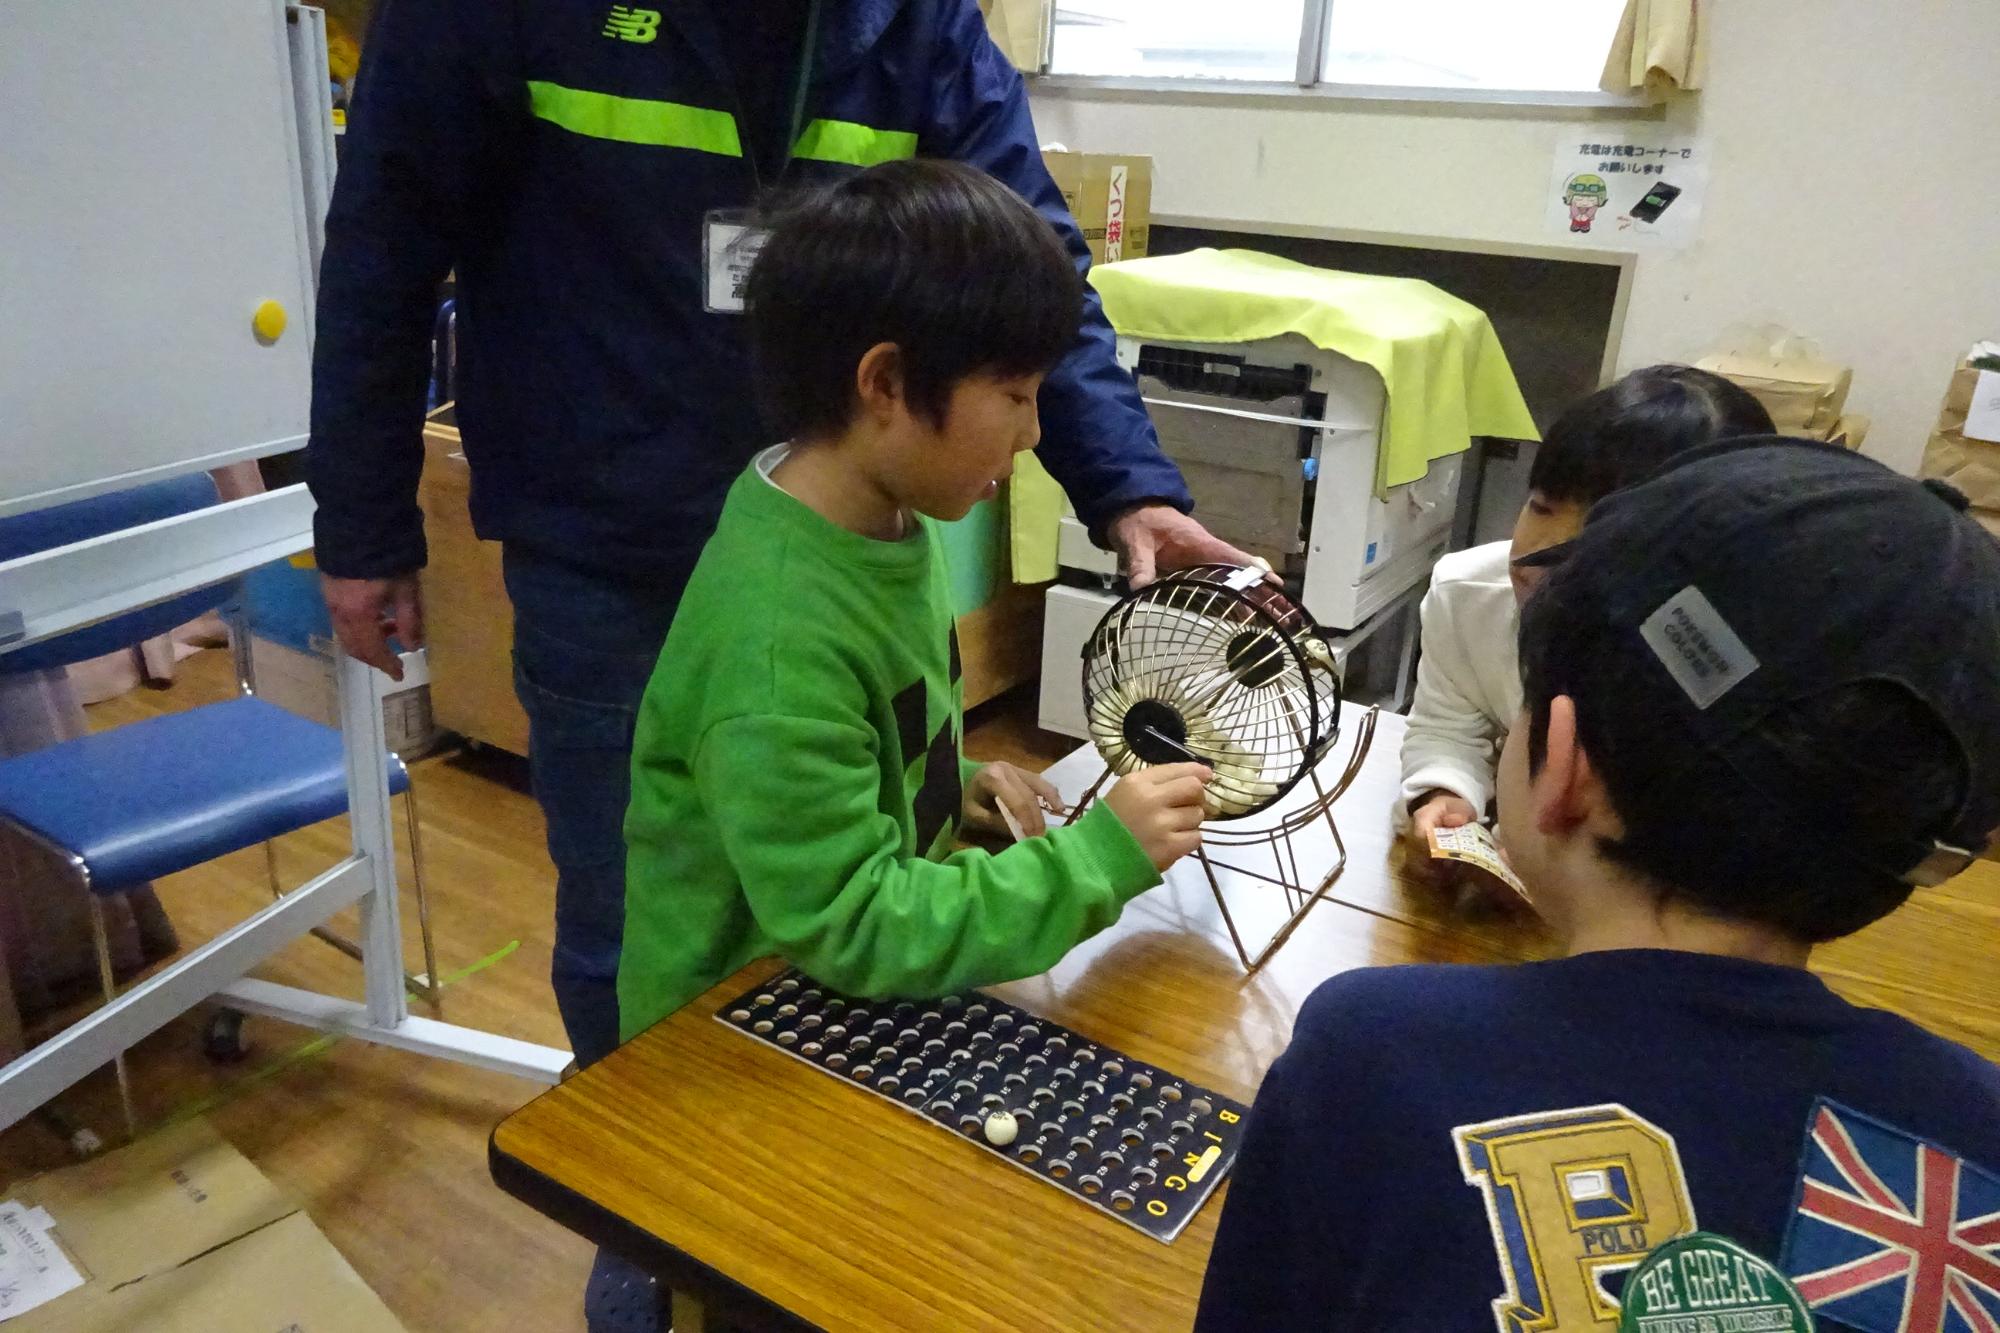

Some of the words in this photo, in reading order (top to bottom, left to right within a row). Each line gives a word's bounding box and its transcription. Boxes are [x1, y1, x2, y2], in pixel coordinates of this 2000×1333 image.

[1579, 144, 1692, 159] 充電は充電コーナーで
[1598, 162, 1664, 175] お願いします
[1581, 1225, 1647, 1254] POLO
[1641, 1258, 1681, 1313] BE
[1680, 1250, 1772, 1308] GREAT
